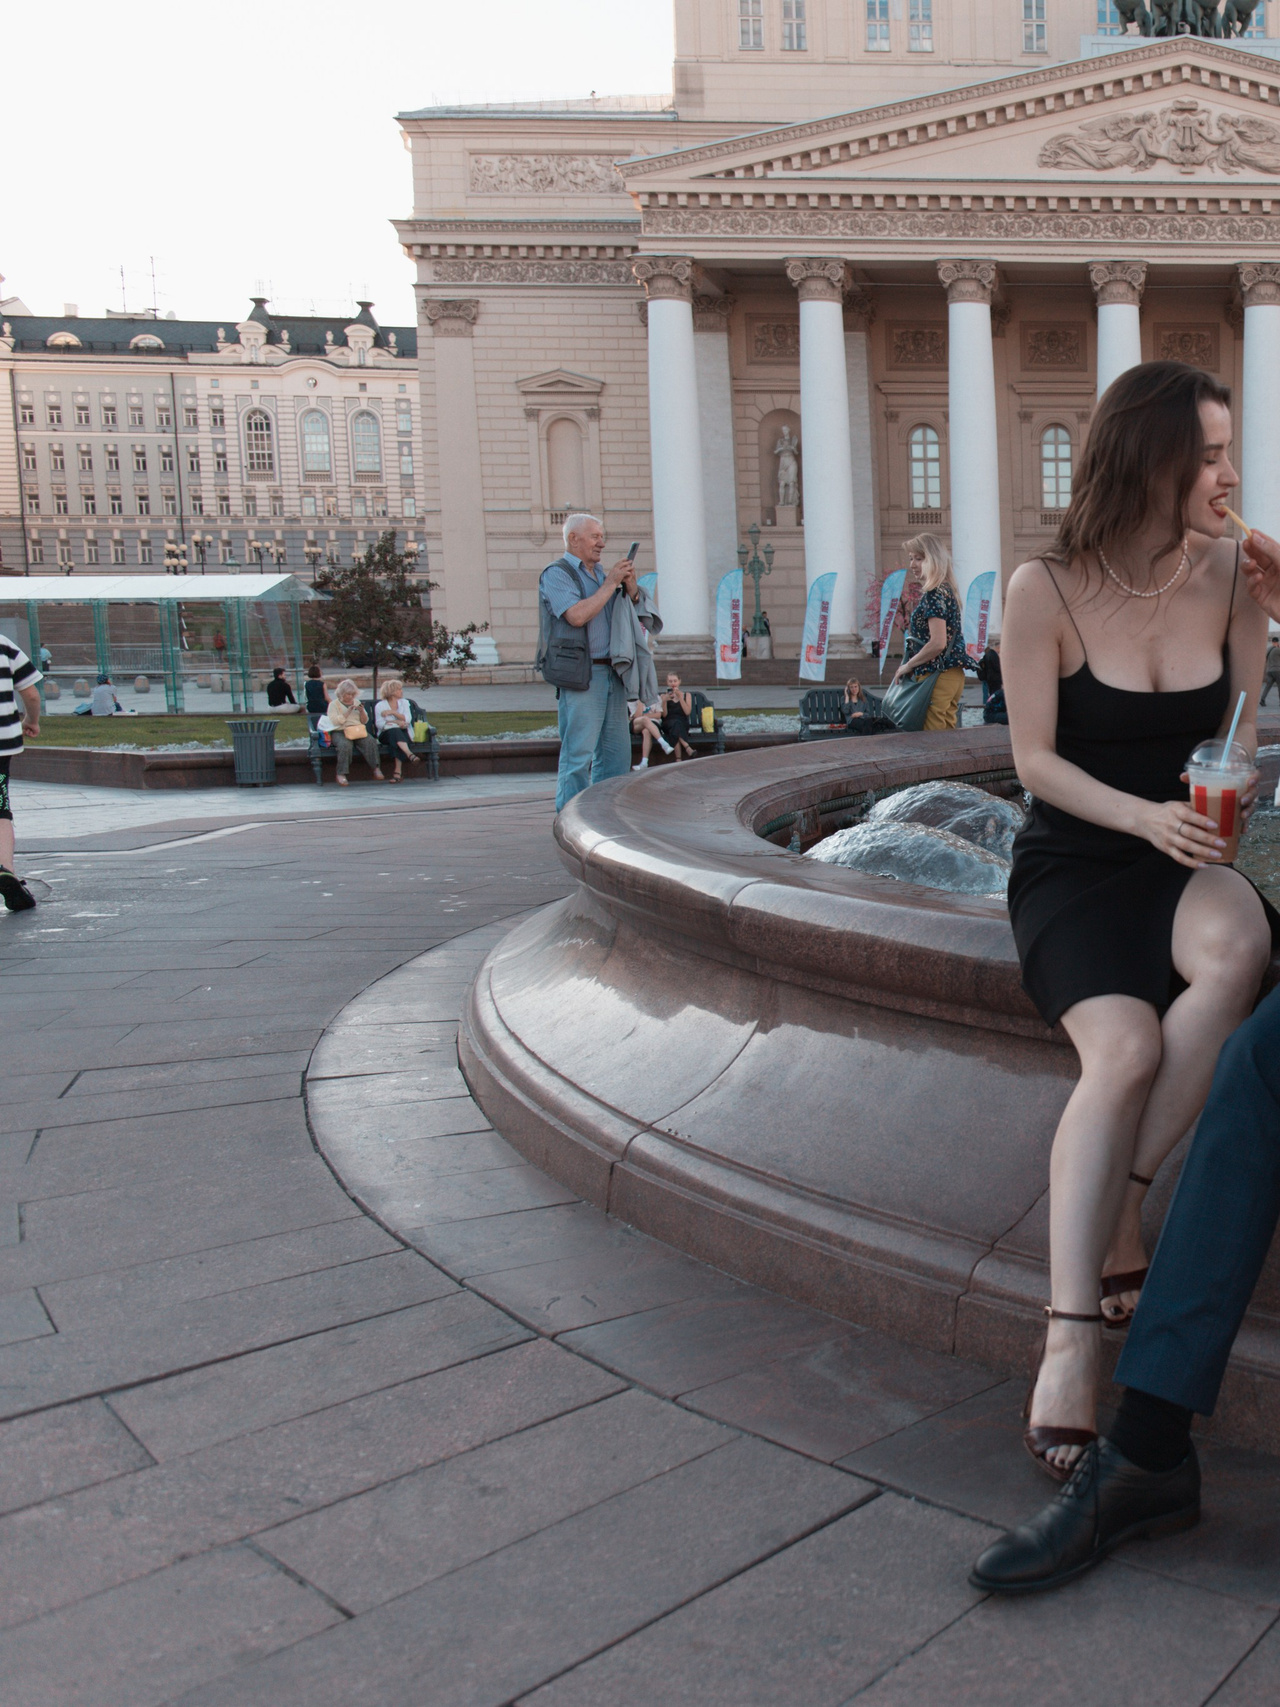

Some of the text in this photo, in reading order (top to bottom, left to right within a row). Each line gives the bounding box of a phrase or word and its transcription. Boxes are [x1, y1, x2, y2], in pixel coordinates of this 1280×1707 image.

[890, 598, 898, 610] ЛЕС
[731, 613, 740, 654] ЧЕРЕШНЕВЫЙ
[817, 615, 828, 656] ЧЕРЕШНЕВЫЙ
[977, 600, 990, 654] ЧЕРЕШНЕВЫЙ ЛЕС
